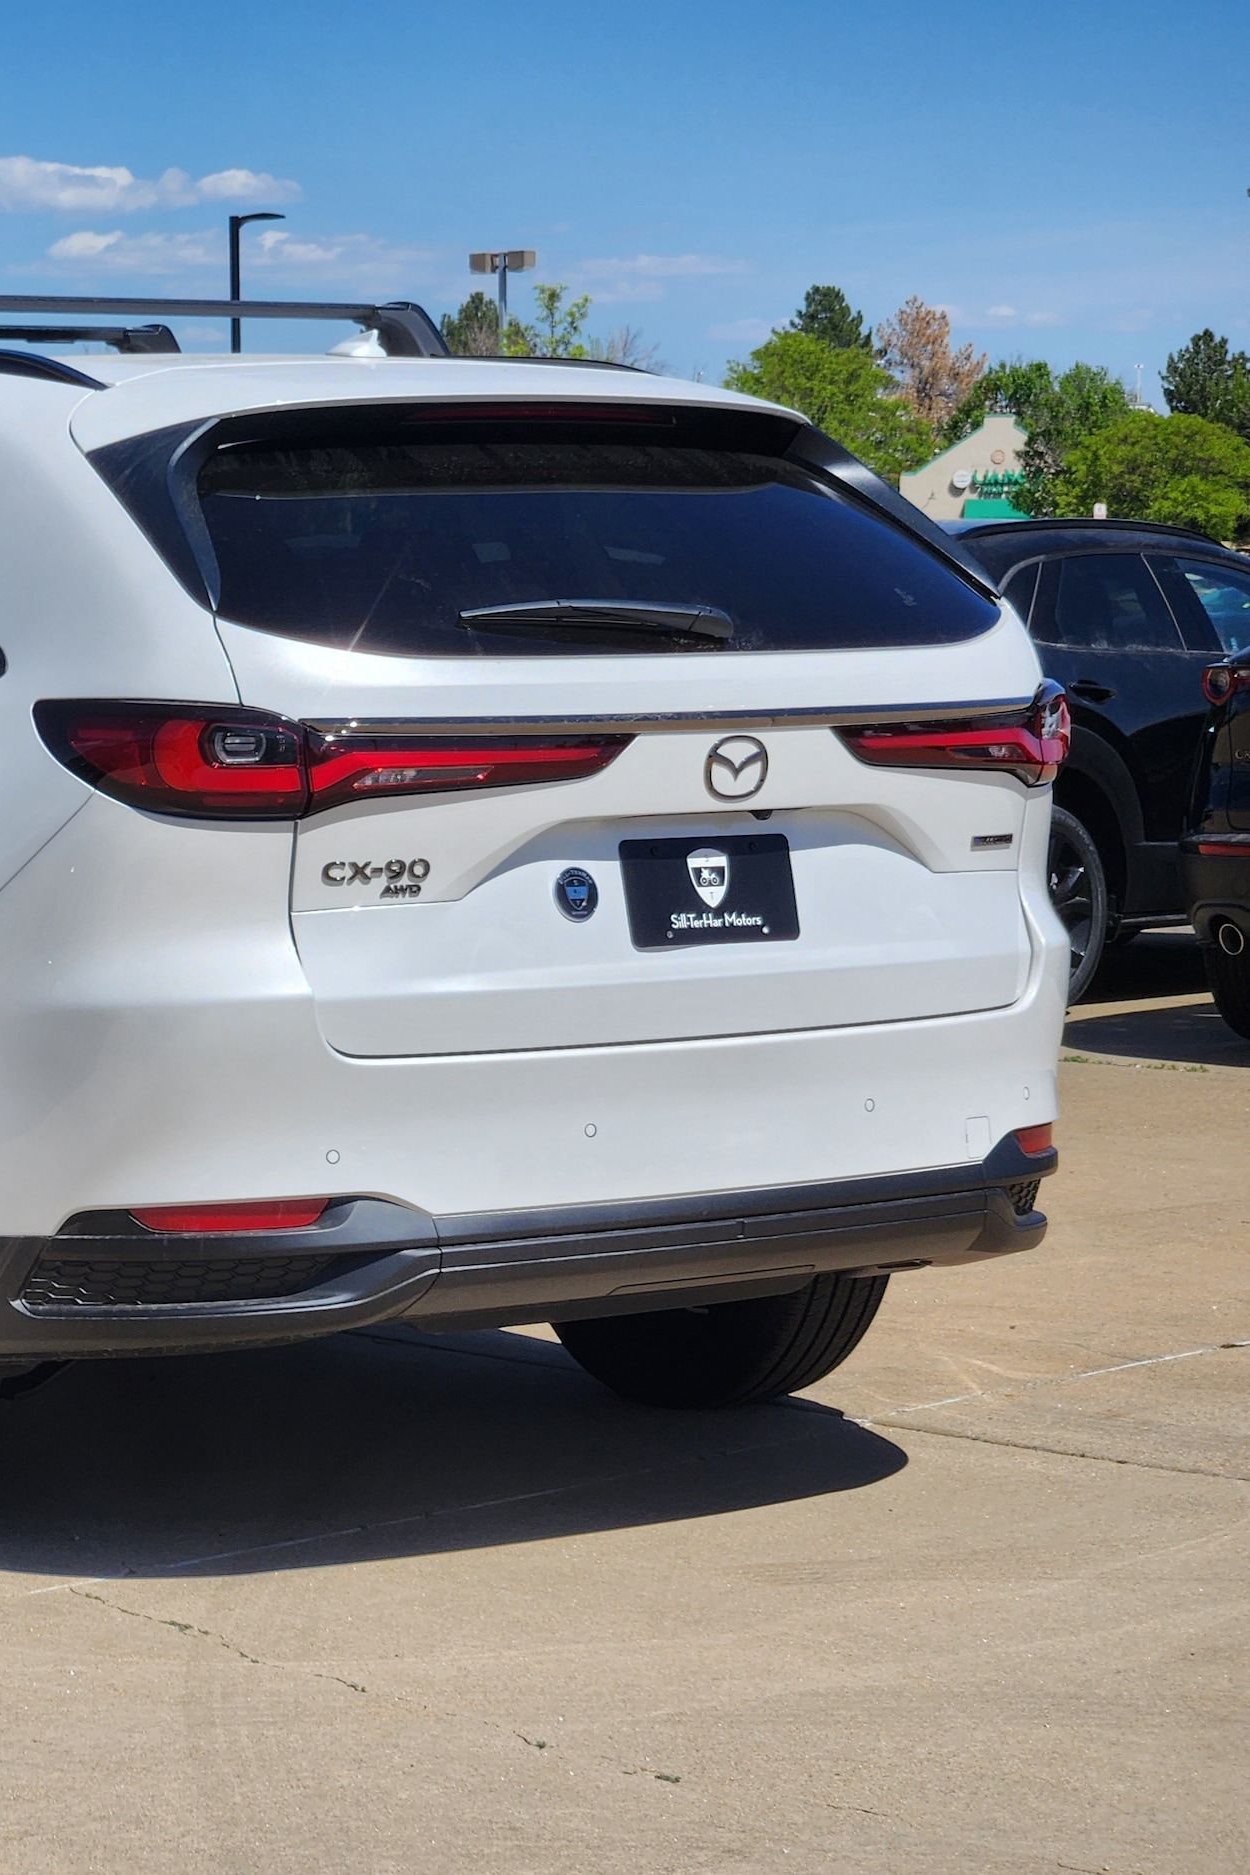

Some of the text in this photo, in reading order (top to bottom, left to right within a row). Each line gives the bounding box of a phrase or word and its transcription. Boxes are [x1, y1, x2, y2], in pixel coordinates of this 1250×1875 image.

[321, 858, 431, 886] CX-90
[380, 884, 422, 899] AWD
[670, 910, 764, 929] Sill-TerHar Motors
